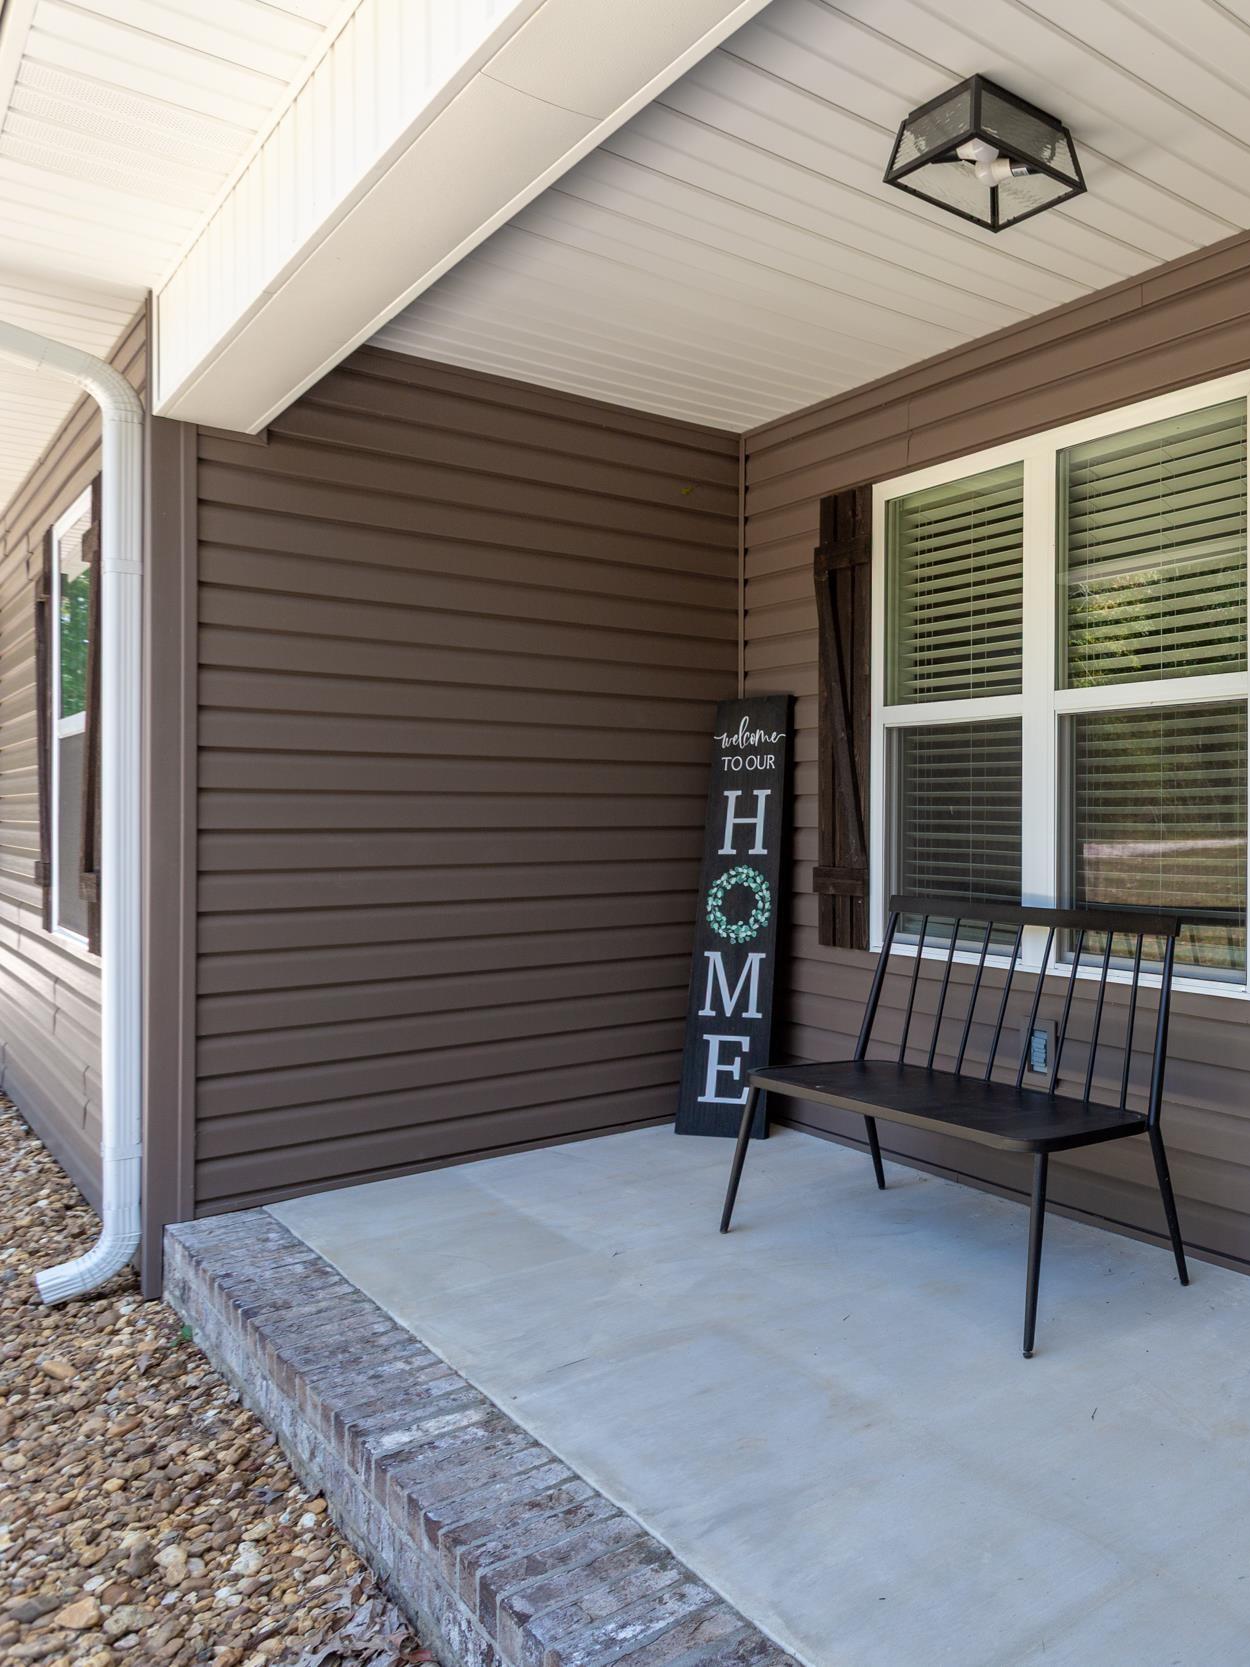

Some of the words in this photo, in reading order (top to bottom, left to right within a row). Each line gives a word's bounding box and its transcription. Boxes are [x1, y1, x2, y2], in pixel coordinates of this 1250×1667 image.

[713, 715, 786, 749] welcome
[721, 756, 743, 771] TO
[745, 754, 775, 770] OUR
